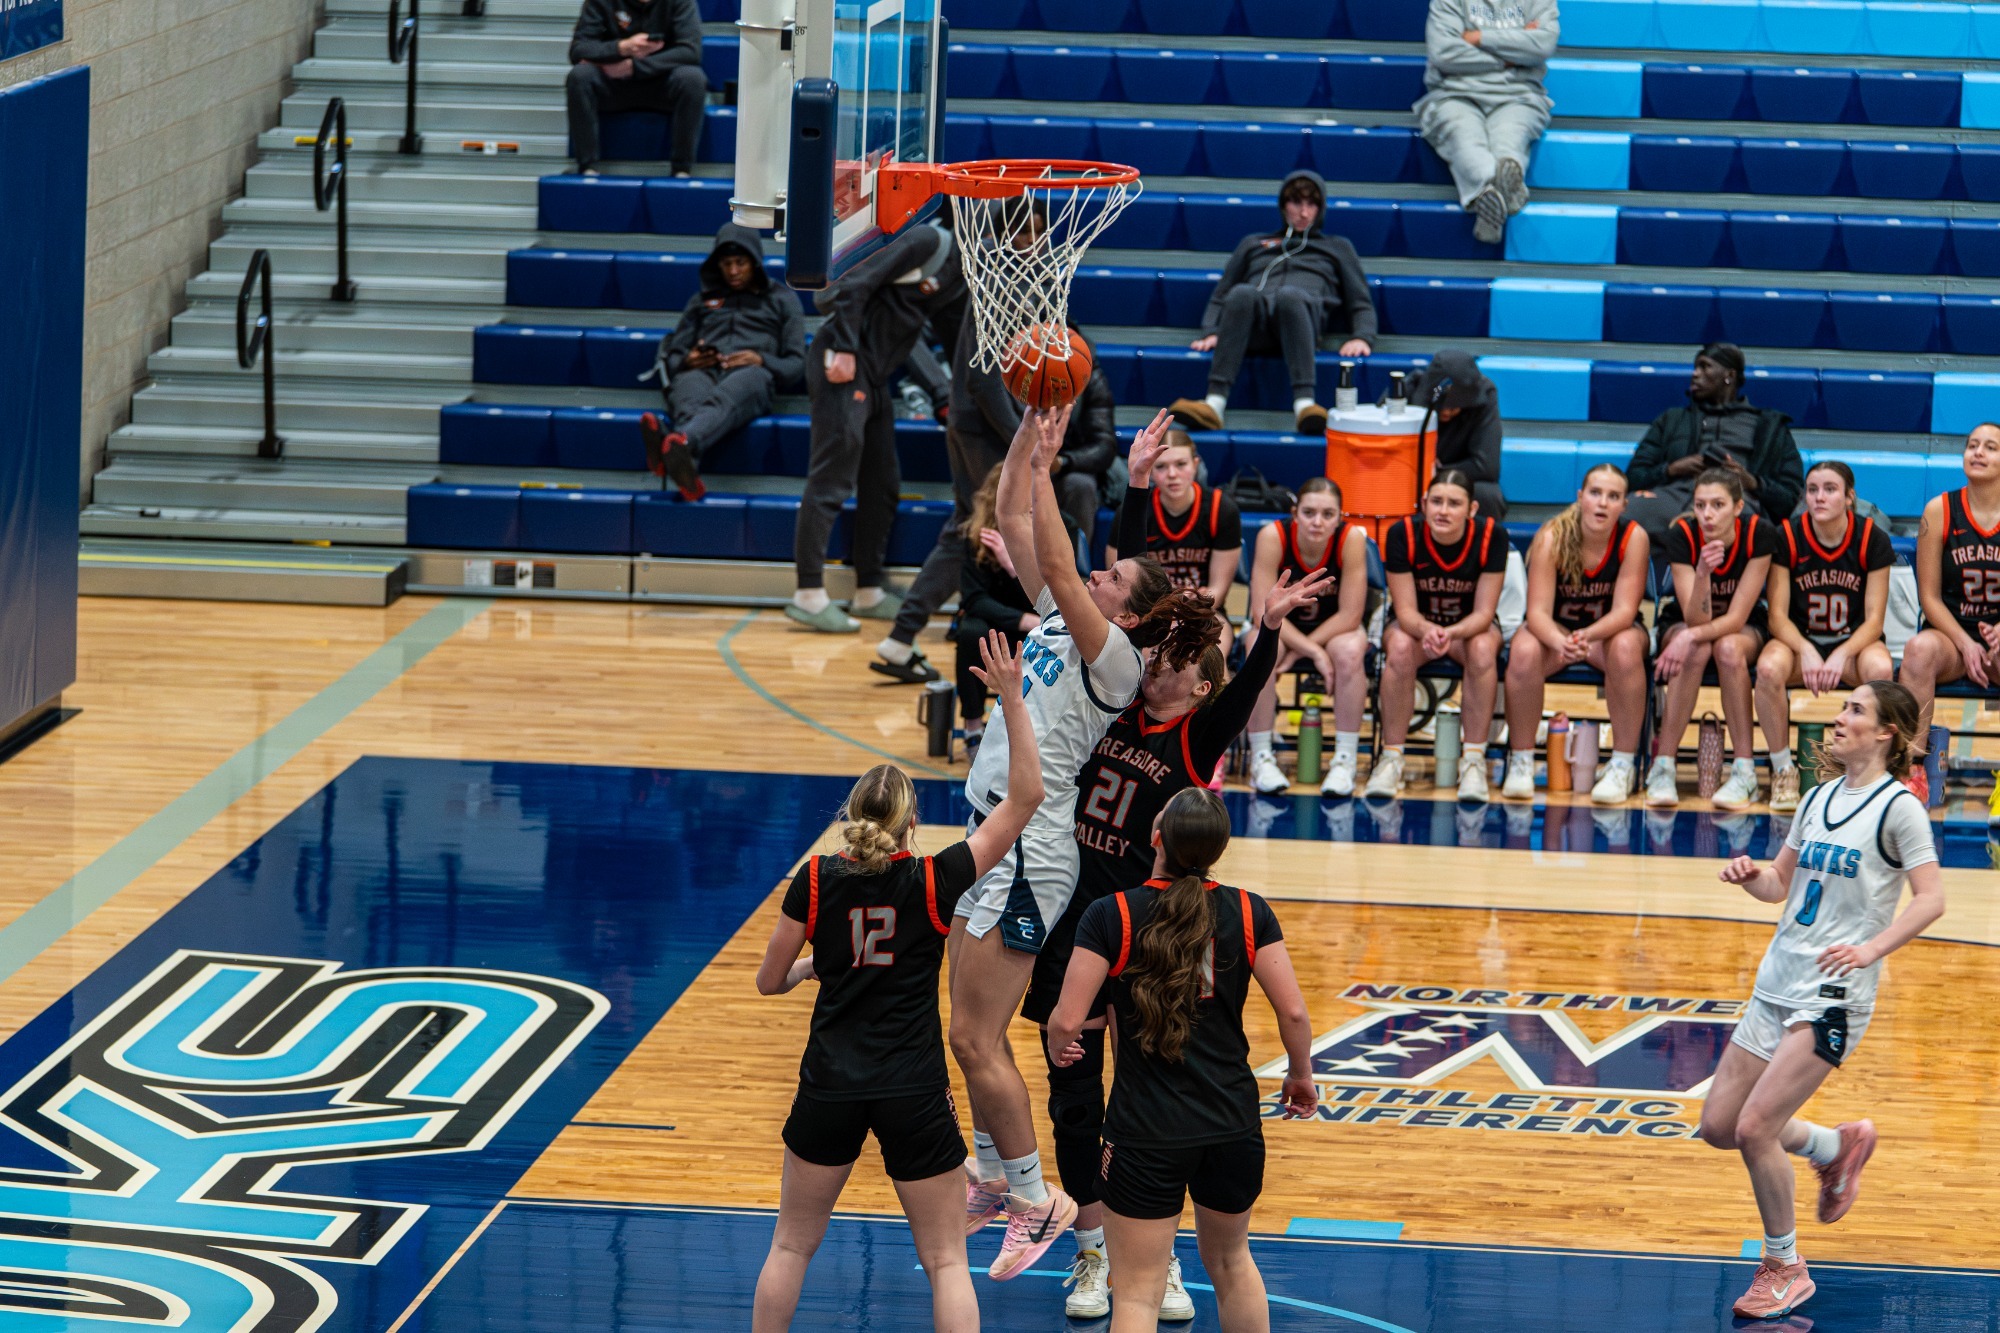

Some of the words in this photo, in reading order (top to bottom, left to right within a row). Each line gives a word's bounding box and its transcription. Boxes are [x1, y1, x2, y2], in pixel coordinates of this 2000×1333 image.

[1795, 568, 1862, 593] TREASURE
[1429, 597, 1462, 616] 15
[1807, 593, 1848, 631] 20
[1022, 635, 1065, 688] WKS
[1092, 736, 1172, 785] REASURE
[1083, 763, 1139, 830] 21
[1796, 839, 1862, 879] AWKS
[1795, 879, 1823, 927] 0
[848, 905, 897, 969] 12
[1336, 981, 1749, 1015] NORTHWE
[1259, 1101, 1703, 1140] ONFERENC
